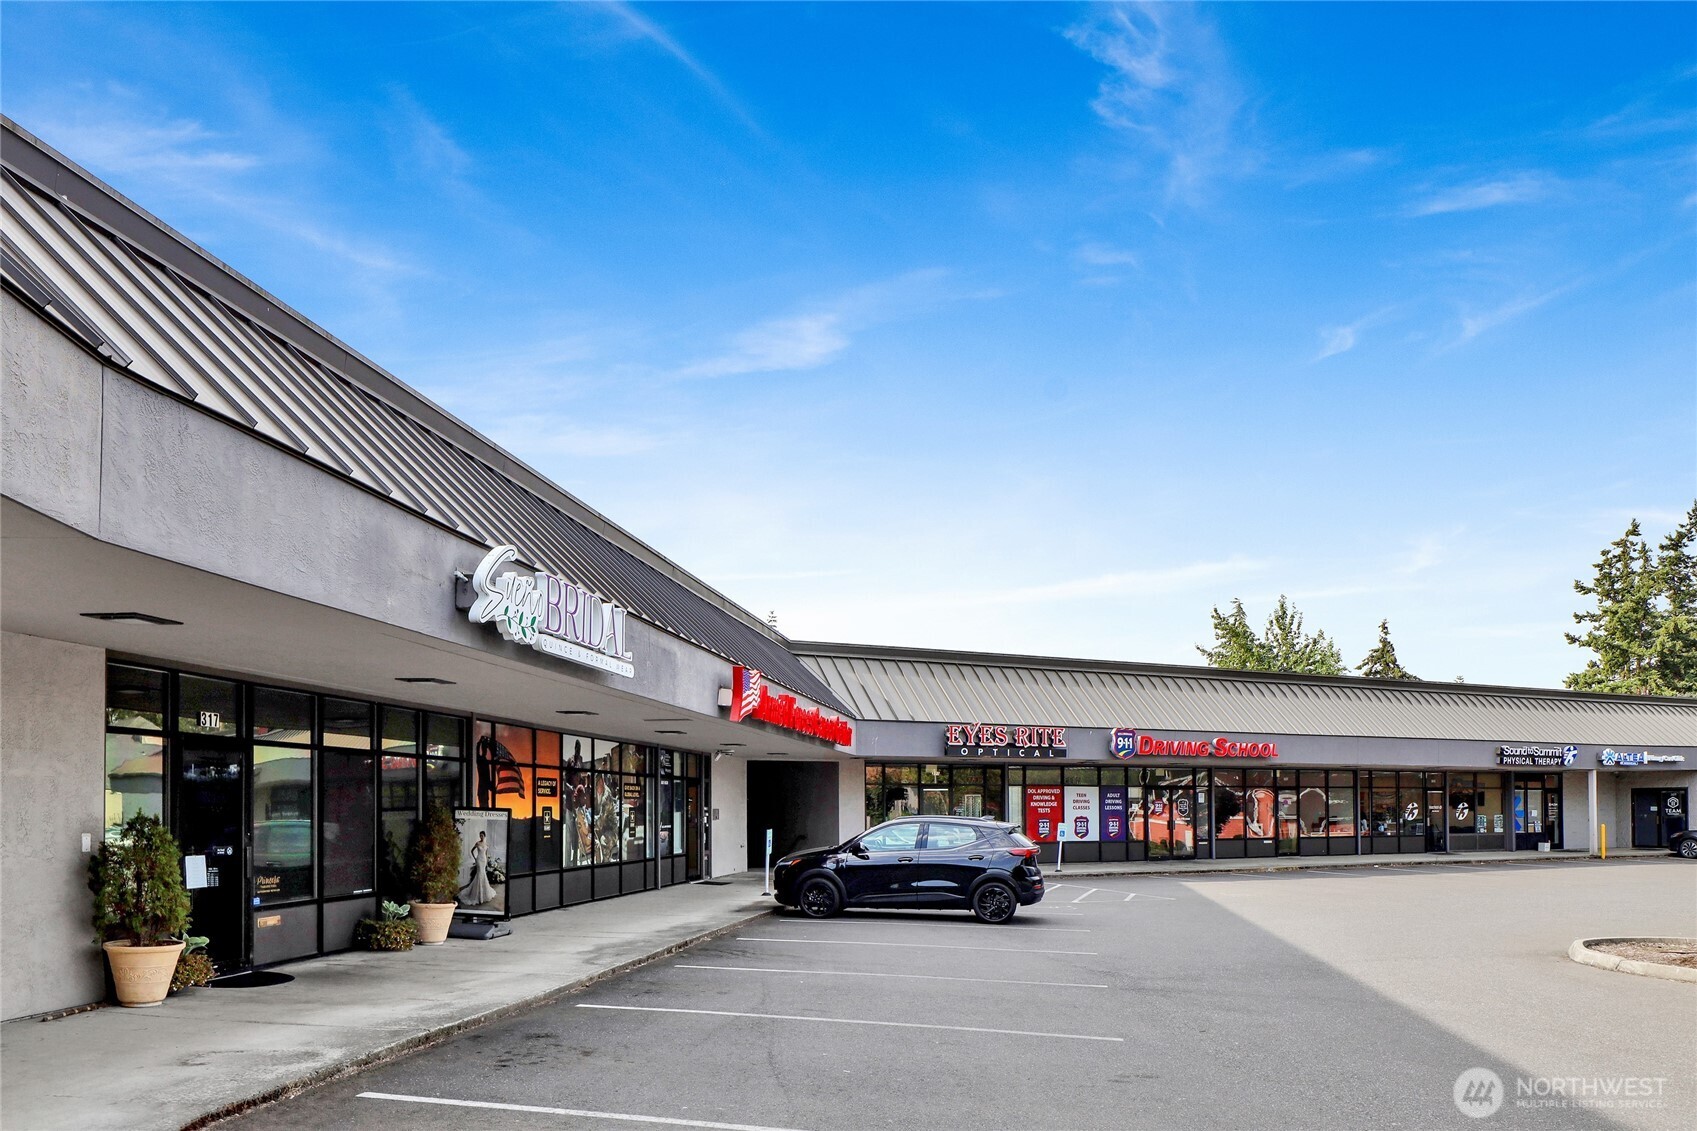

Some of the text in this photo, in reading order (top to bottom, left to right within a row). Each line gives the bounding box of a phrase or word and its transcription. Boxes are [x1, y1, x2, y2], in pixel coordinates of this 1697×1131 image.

[545, 574, 633, 660] BRIDAL
[542, 638, 573, 656] QUINCE
[585, 652, 612, 669] FORMAL
[201, 712, 219, 727] 317
[948, 722, 1067, 747] EYES RITE
[960, 747, 1054, 757] OPTICAL
[1138, 735, 1210, 757] DRIVING
[1213, 737, 1279, 757] SCHOOL
[1503, 745, 1527, 755] Sound
[1534, 746, 1562, 757] Summit
[1503, 756, 1562, 766] PHYSICAL THERAPY
[458, 810, 484, 818] Wedding
